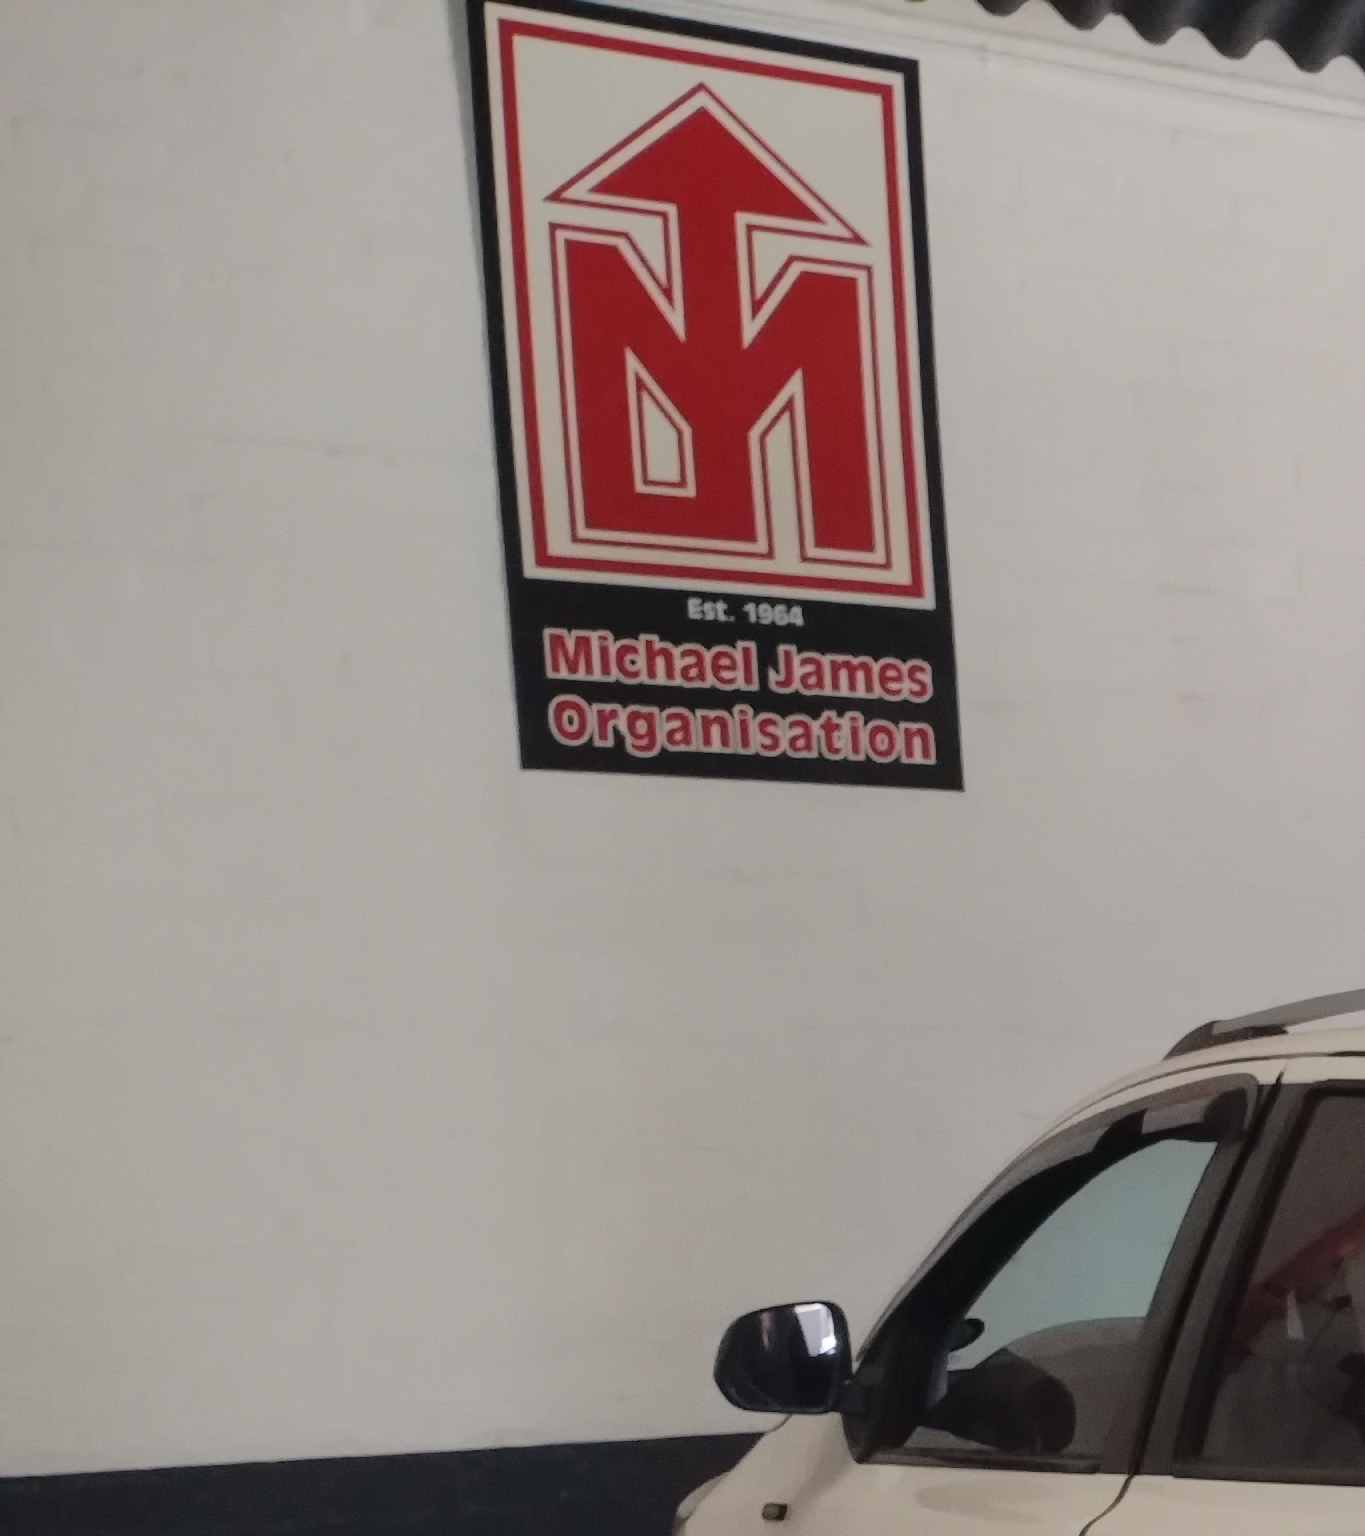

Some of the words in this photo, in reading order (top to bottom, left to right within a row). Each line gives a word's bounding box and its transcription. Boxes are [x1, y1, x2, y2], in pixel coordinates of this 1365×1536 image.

[687, 597, 734, 622] Est.
[743, 601, 805, 627] 1964
[544, 627, 759, 691] Michael
[769, 644, 933, 702] James
[548, 695, 937, 765] Organisation
